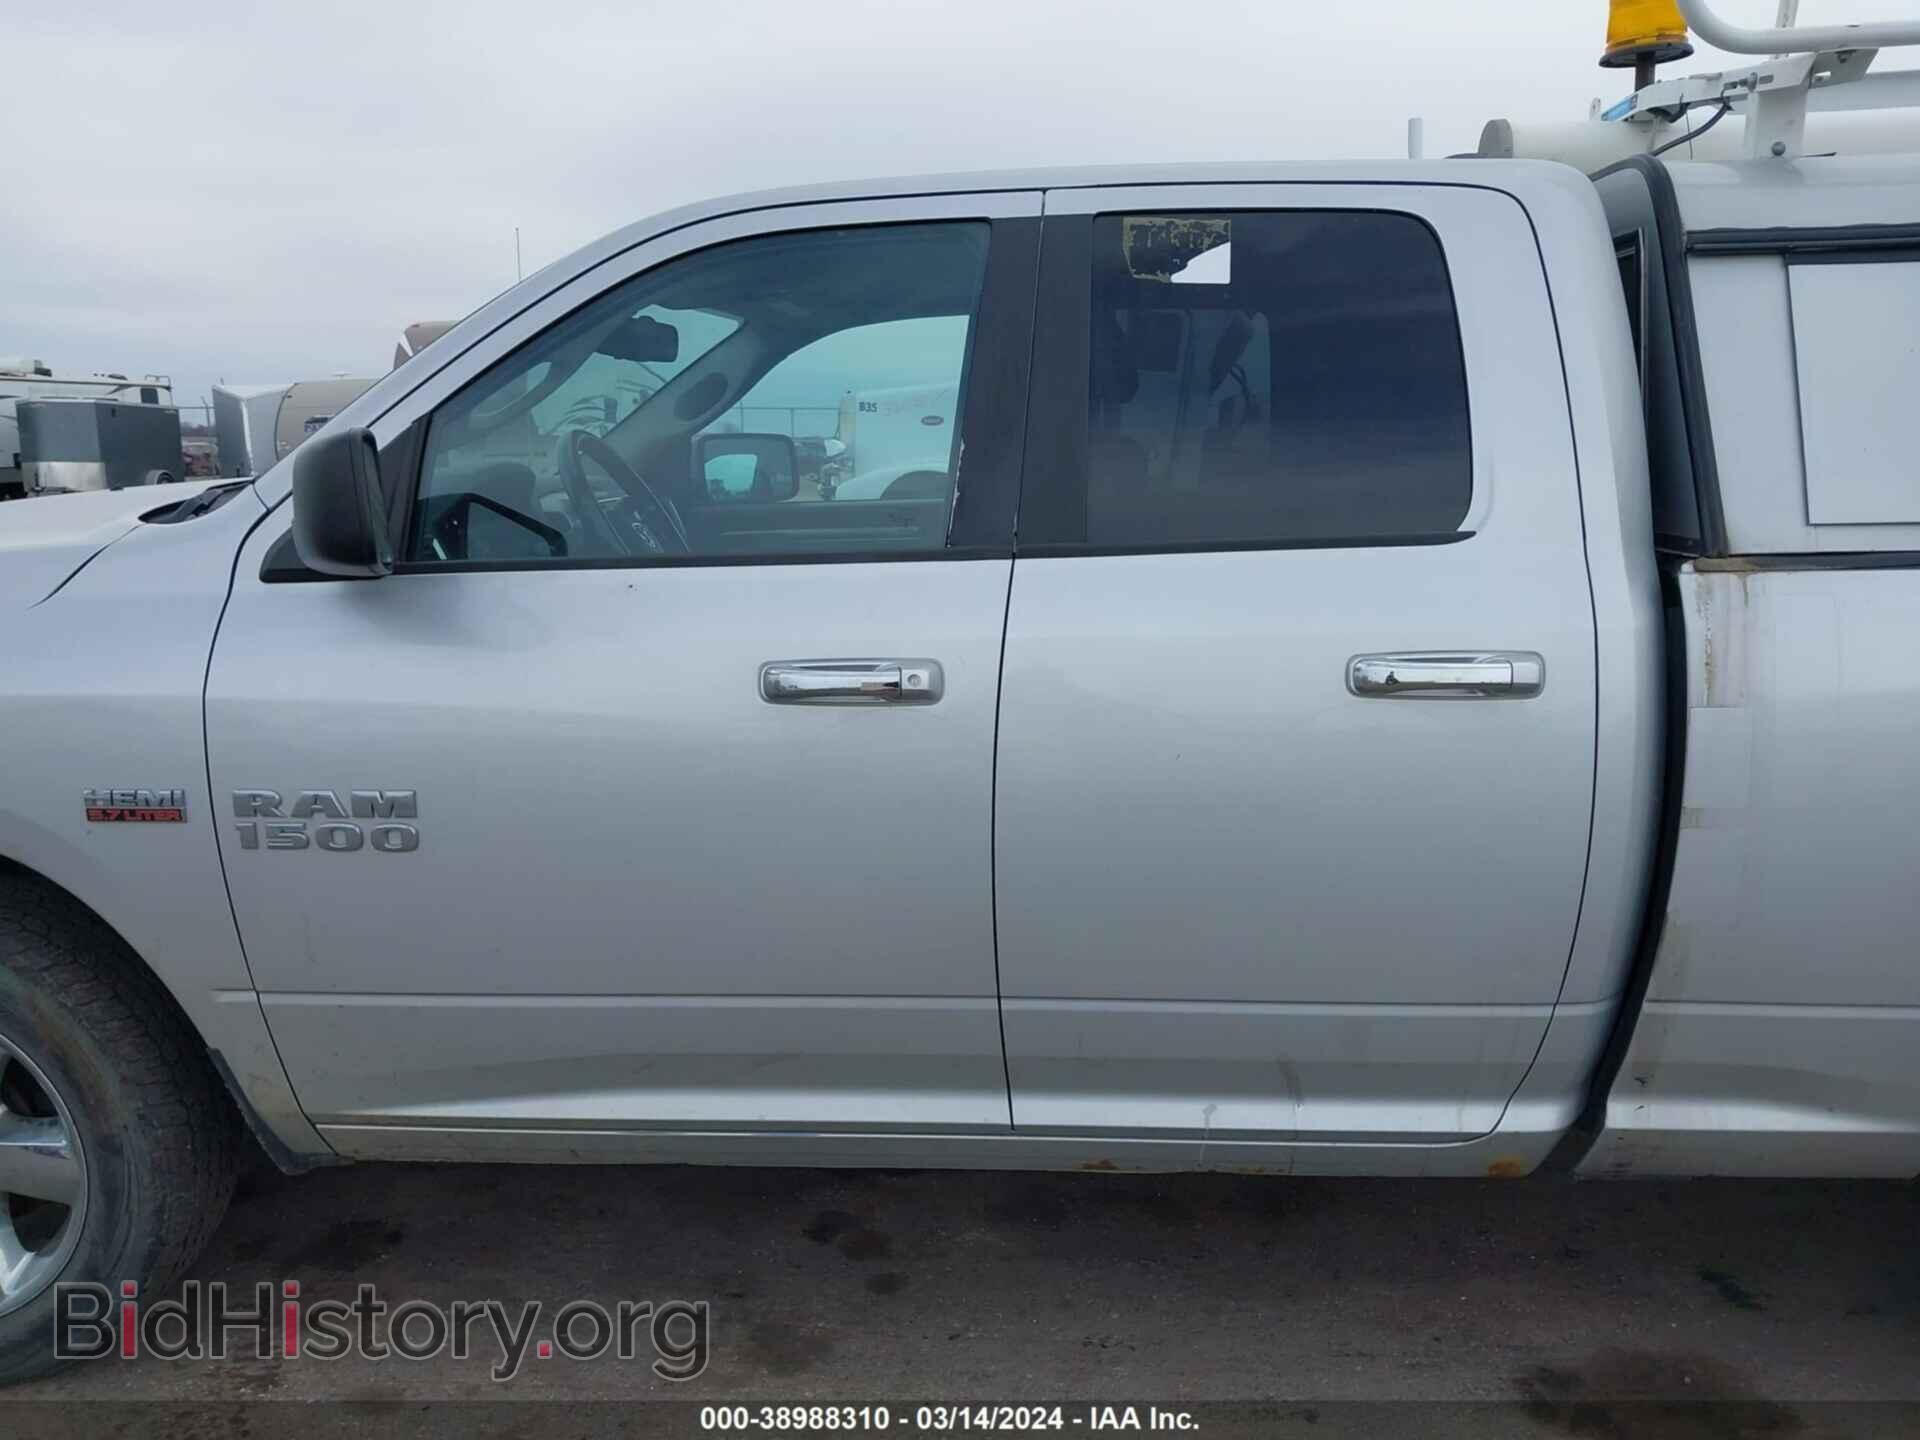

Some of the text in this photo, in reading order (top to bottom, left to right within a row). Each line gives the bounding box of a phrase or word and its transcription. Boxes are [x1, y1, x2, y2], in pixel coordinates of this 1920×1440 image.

[83, 789, 185, 807] HEMI
[232, 789, 418, 818] RAM
[122, 808, 183, 821] LITER
[235, 822, 421, 852] 1500
